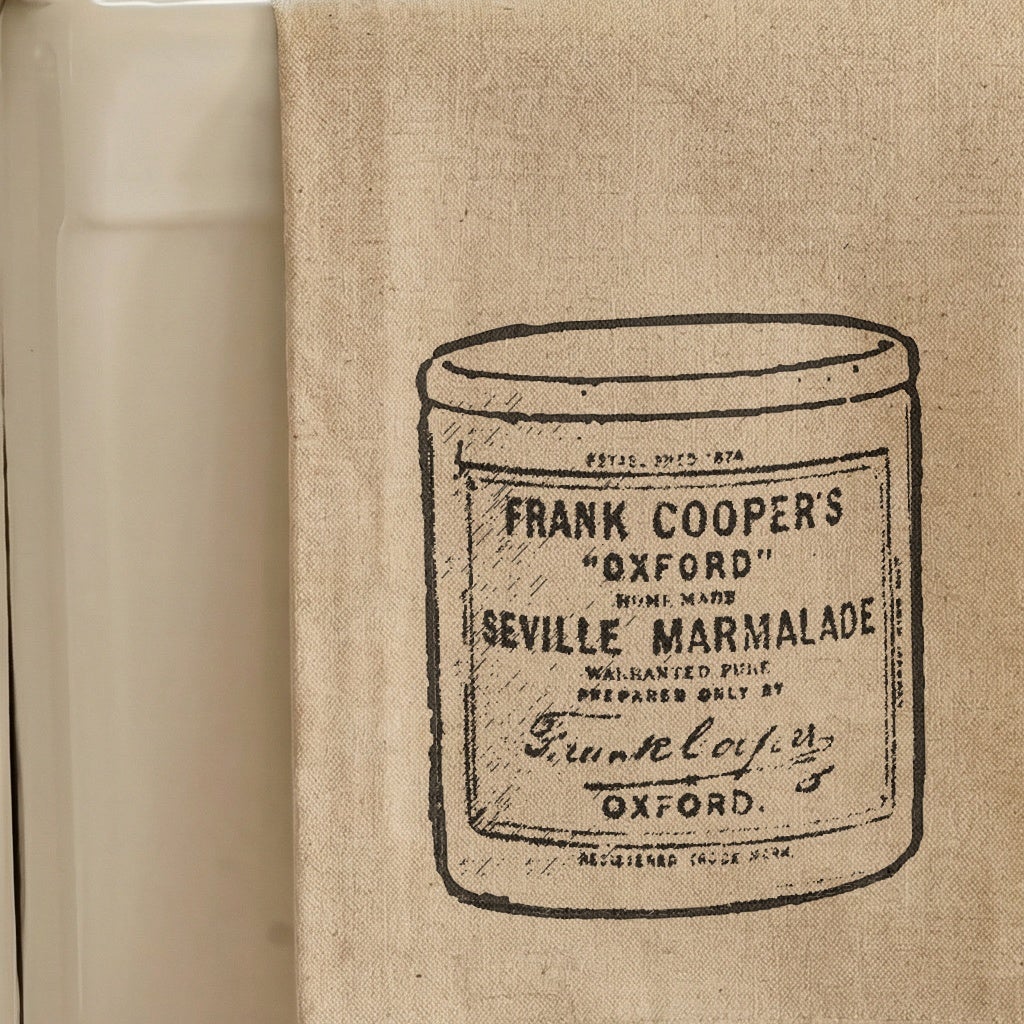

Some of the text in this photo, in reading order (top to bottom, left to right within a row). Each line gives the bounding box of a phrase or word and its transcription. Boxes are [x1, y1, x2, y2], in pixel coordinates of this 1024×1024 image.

[505, 487, 843, 541] FRANK COOPER'S
[680, 589, 736, 607] MADE
[481, 596, 876, 656] SEVILLE MARMALADE
[577, 682, 784, 704] PREPARED ONLY BY
